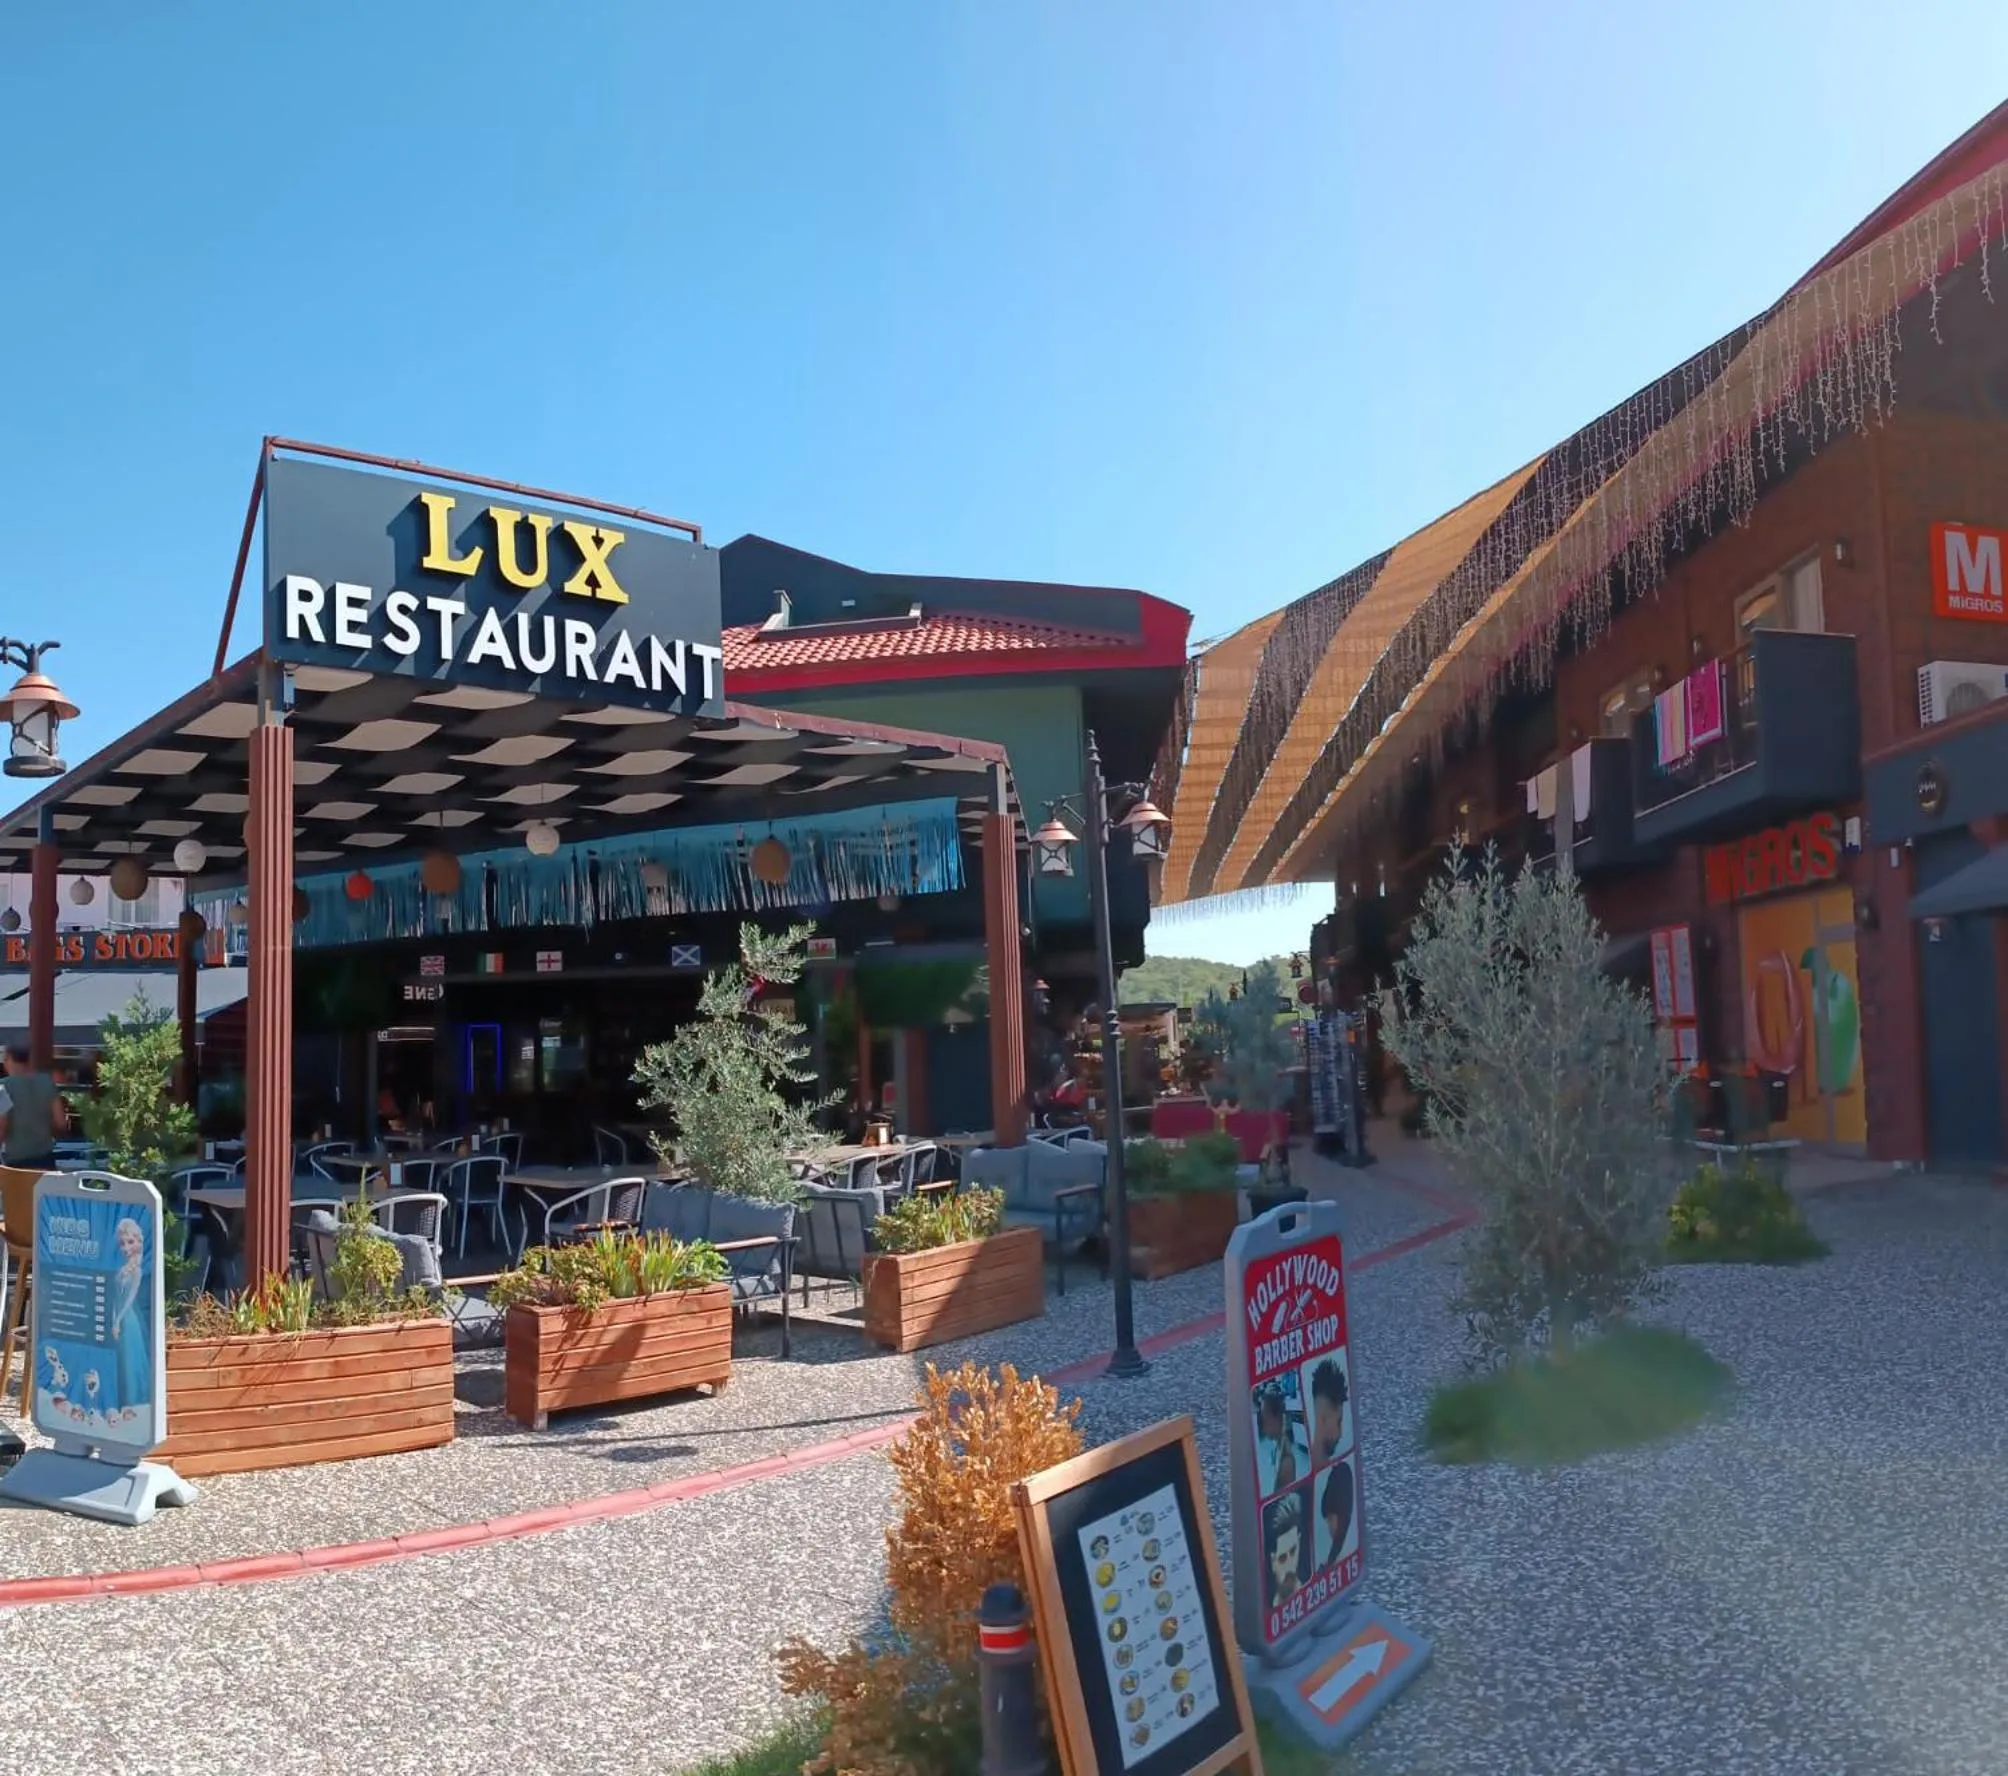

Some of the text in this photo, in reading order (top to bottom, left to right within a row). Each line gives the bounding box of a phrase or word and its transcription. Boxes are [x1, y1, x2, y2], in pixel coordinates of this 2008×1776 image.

[420, 492, 630, 605] LUX
[1944, 530, 2002, 596] M
[286, 575, 722, 700] RESTAURANT
[1248, 1253, 1340, 1332] HOLLYWOOD
[1254, 1314, 1339, 1377] BARBER SHOP
[1271, 1612, 1280, 1637] 0
[1281, 1593, 1304, 1629] 542
